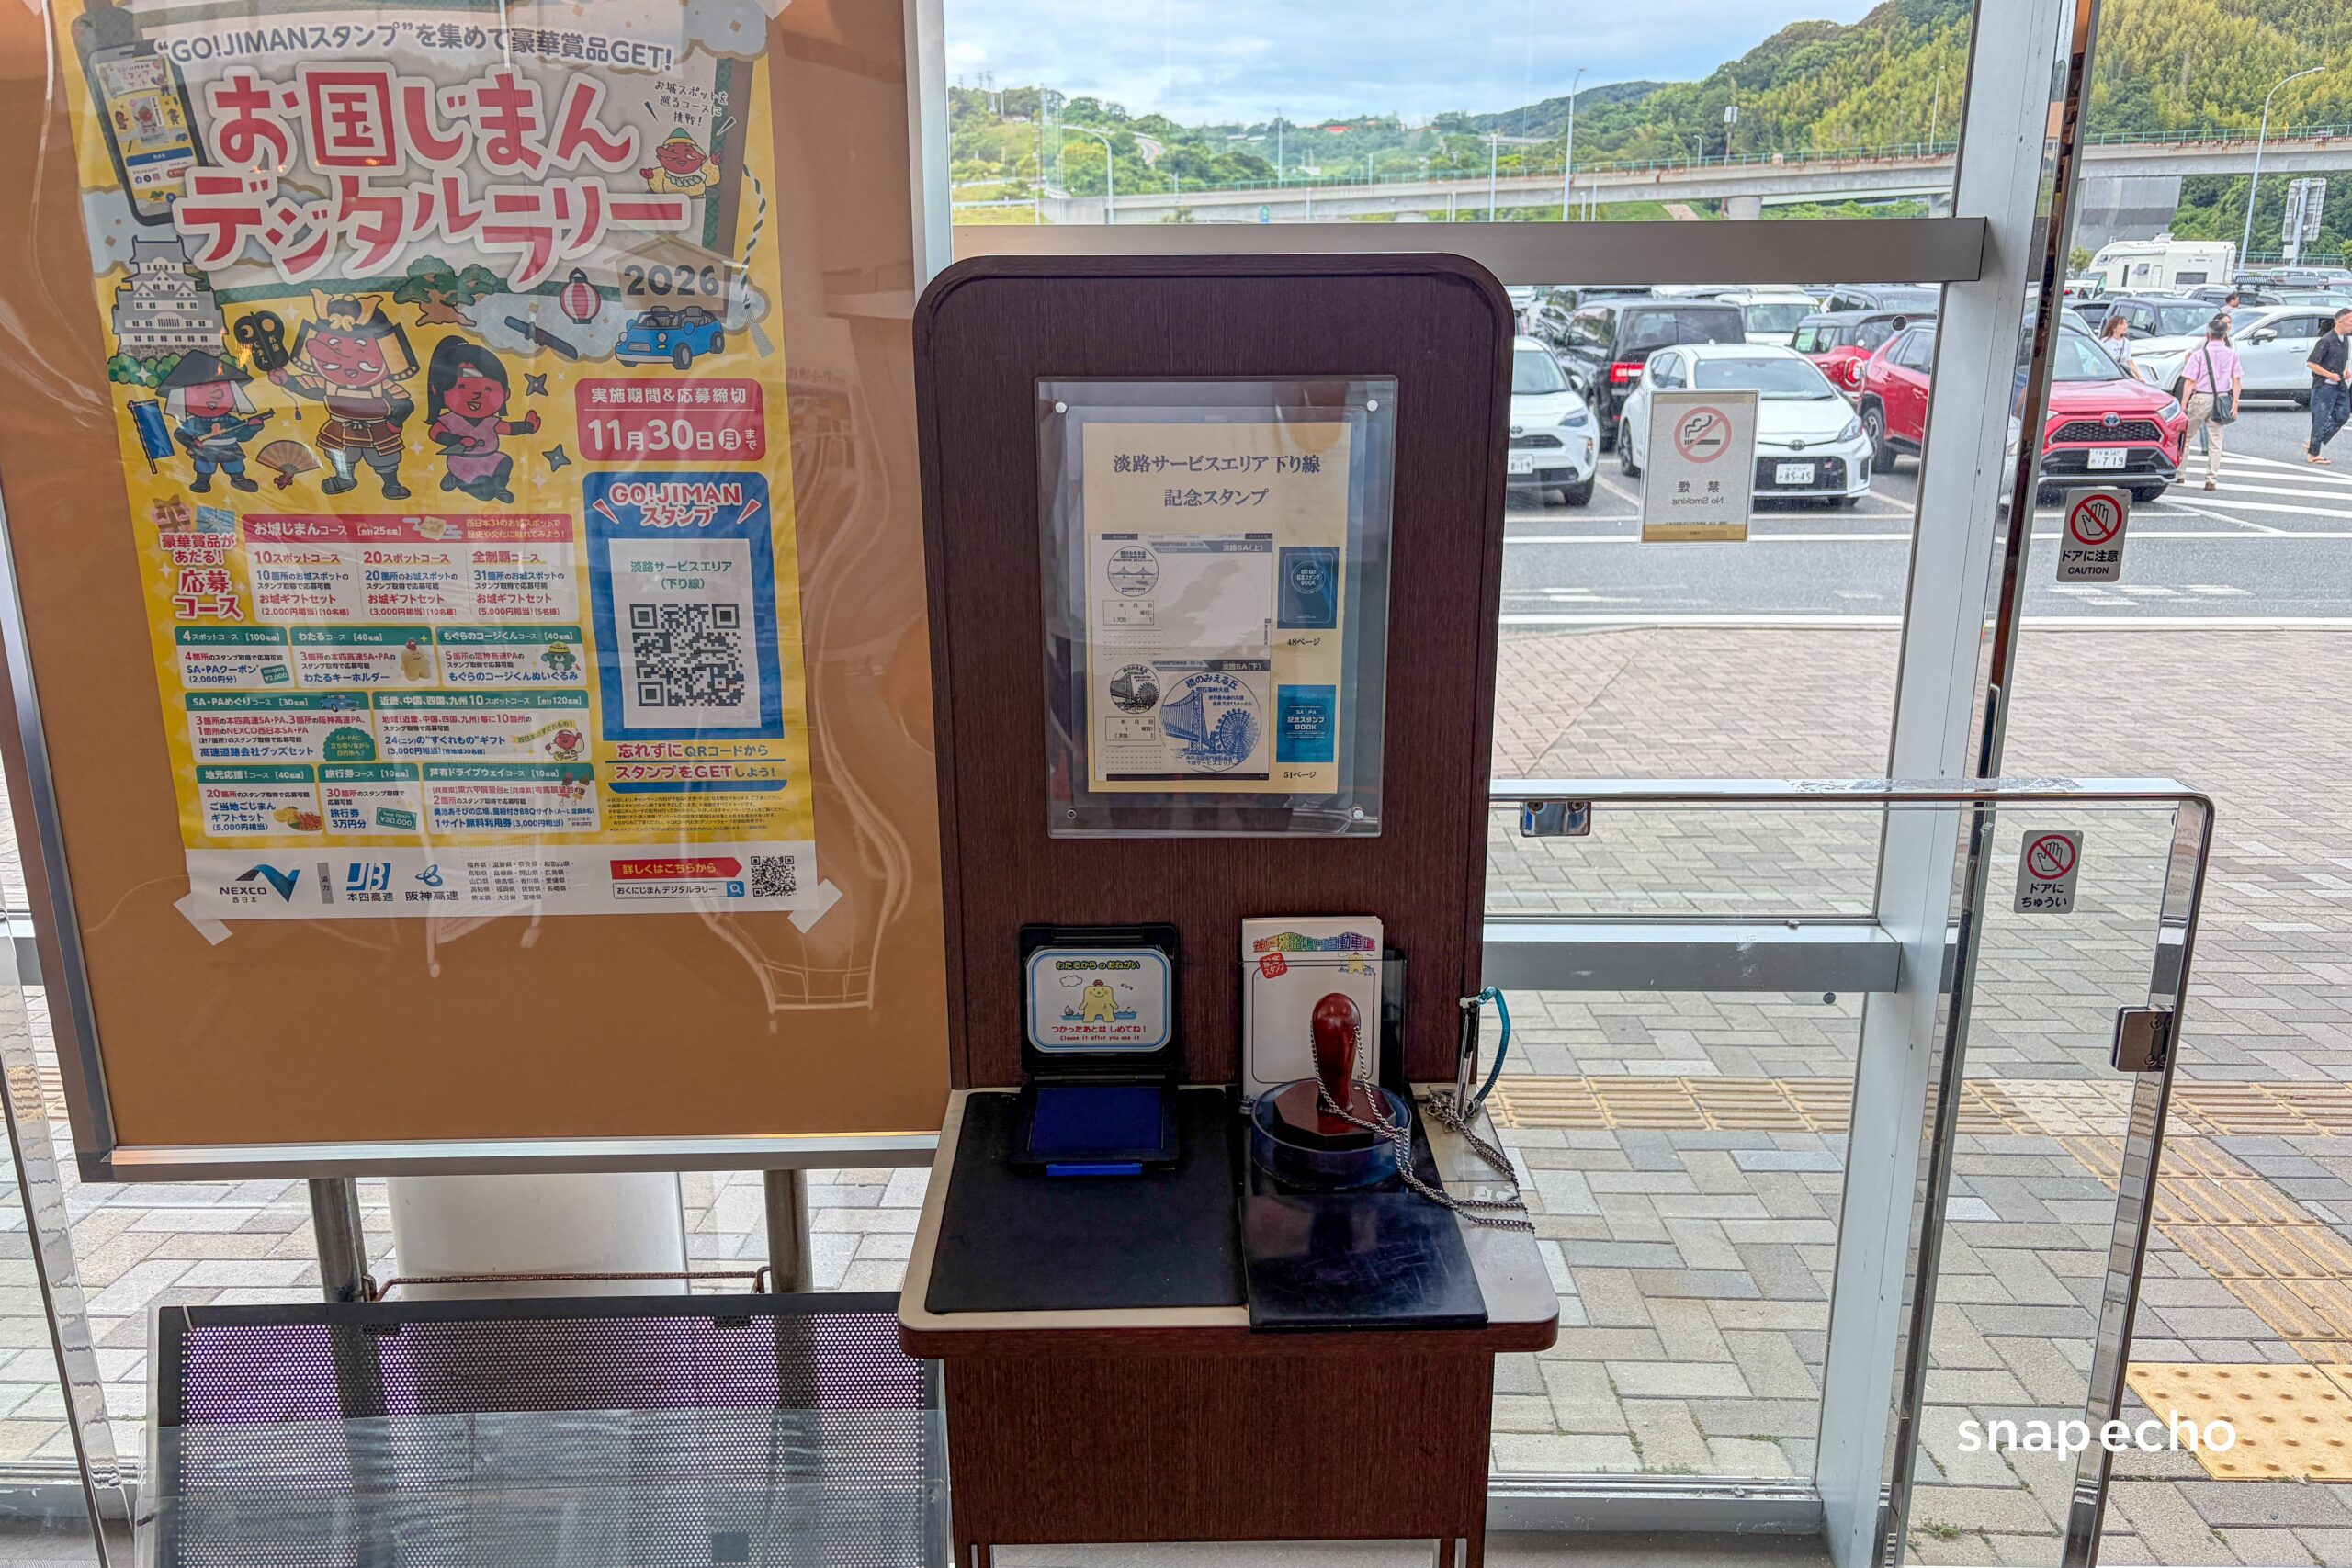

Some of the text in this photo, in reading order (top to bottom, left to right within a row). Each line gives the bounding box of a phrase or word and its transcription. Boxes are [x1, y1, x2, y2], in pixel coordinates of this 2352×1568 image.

[655, 81, 728, 105] お城スポットを
[660, 96, 722, 117] 巡るコースに
[212, 71, 631, 172] お国じまん
[673, 111, 702, 126] 挑戦!
[182, 176, 683, 287] デジタルラリー
[623, 264, 720, 297] 2026
[591, 387, 746, 404] 実施期間&応募締切
[1114, 454, 1321, 474] 淡路サービスエリア下り線
[611, 485, 741, 504] GO!JIMAN
[1164, 488, 1270, 507] 記念スタンプ
[641, 506, 717, 525] スタンプ
[254, 522, 347, 536] お城じまんコース
[161, 533, 236, 549] 豪華賞品が
[175, 550, 224, 564] あたる!
[255, 551, 340, 563] 10スポットコース
[363, 551, 450, 564] 20スポットコース
[472, 550, 540, 563] 全制覇コース
[2062, 550, 2120, 562] ドアに注意
[630, 561, 732, 573] 淡路サービスエリア
[2067, 566, 2109, 575] CAUTION
[256, 570, 349, 581] 10箇所のお城スポットの
[365, 570, 458, 581] 20箇所のお城スポットの
[474, 570, 565, 581] 31箇所のお城スポットの
[181, 570, 230, 593] 応募
[257, 582, 332, 591] スタンプ取得で応募可能
[366, 581, 440, 590] スタンプ取得で応募可能
[475, 581, 548, 590] スタンプ取得で応募可能
[661, 578, 705, 590] (下り線)
[259, 593, 336, 604] お城ギフトセット
[368, 593, 445, 604] お城ギフトセット
[476, 593, 552, 604] お城ギフトセット
[175, 597, 242, 619] コース
[182, 630, 238, 641] 4スポットコース
[298, 631, 346, 641] わたるコース
[443, 631, 537, 641] もぐらのコージくんコース
[1286, 637, 1320, 647] 48ページ
[303, 672, 390, 682] わたるキーホルダー
[448, 671, 579, 682] もぐらのコージくんぬいぐるみ
[1185, 673, 1239, 690] 橋のみえる丘
[199, 746, 314, 758] 高速道路会社グッズセット
[616, 743, 769, 759] 忘れずにQRコードから
[324, 768, 374, 779] 旅行券コース
[616, 765, 776, 780] スタンプをGETしよう!
[1283, 771, 1317, 779] 51ページ
[209, 800, 277, 811] ご当地ごじまん
[211, 812, 265, 822] ギフトセット
[329, 808, 360, 818] 旅行券
[332, 818, 367, 829] 3万円分
[622, 863, 717, 874] 詳しくはこちらから
[220, 886, 267, 896] NEXCO
[616, 885, 718, 896] おくにじまんデジタルラリー
[2030, 883, 2064, 894] ドアに
[347, 892, 394, 902] 本四高速
[405, 891, 459, 901] 阪神高速
[2021, 896, 2067, 908] ちゅうい
